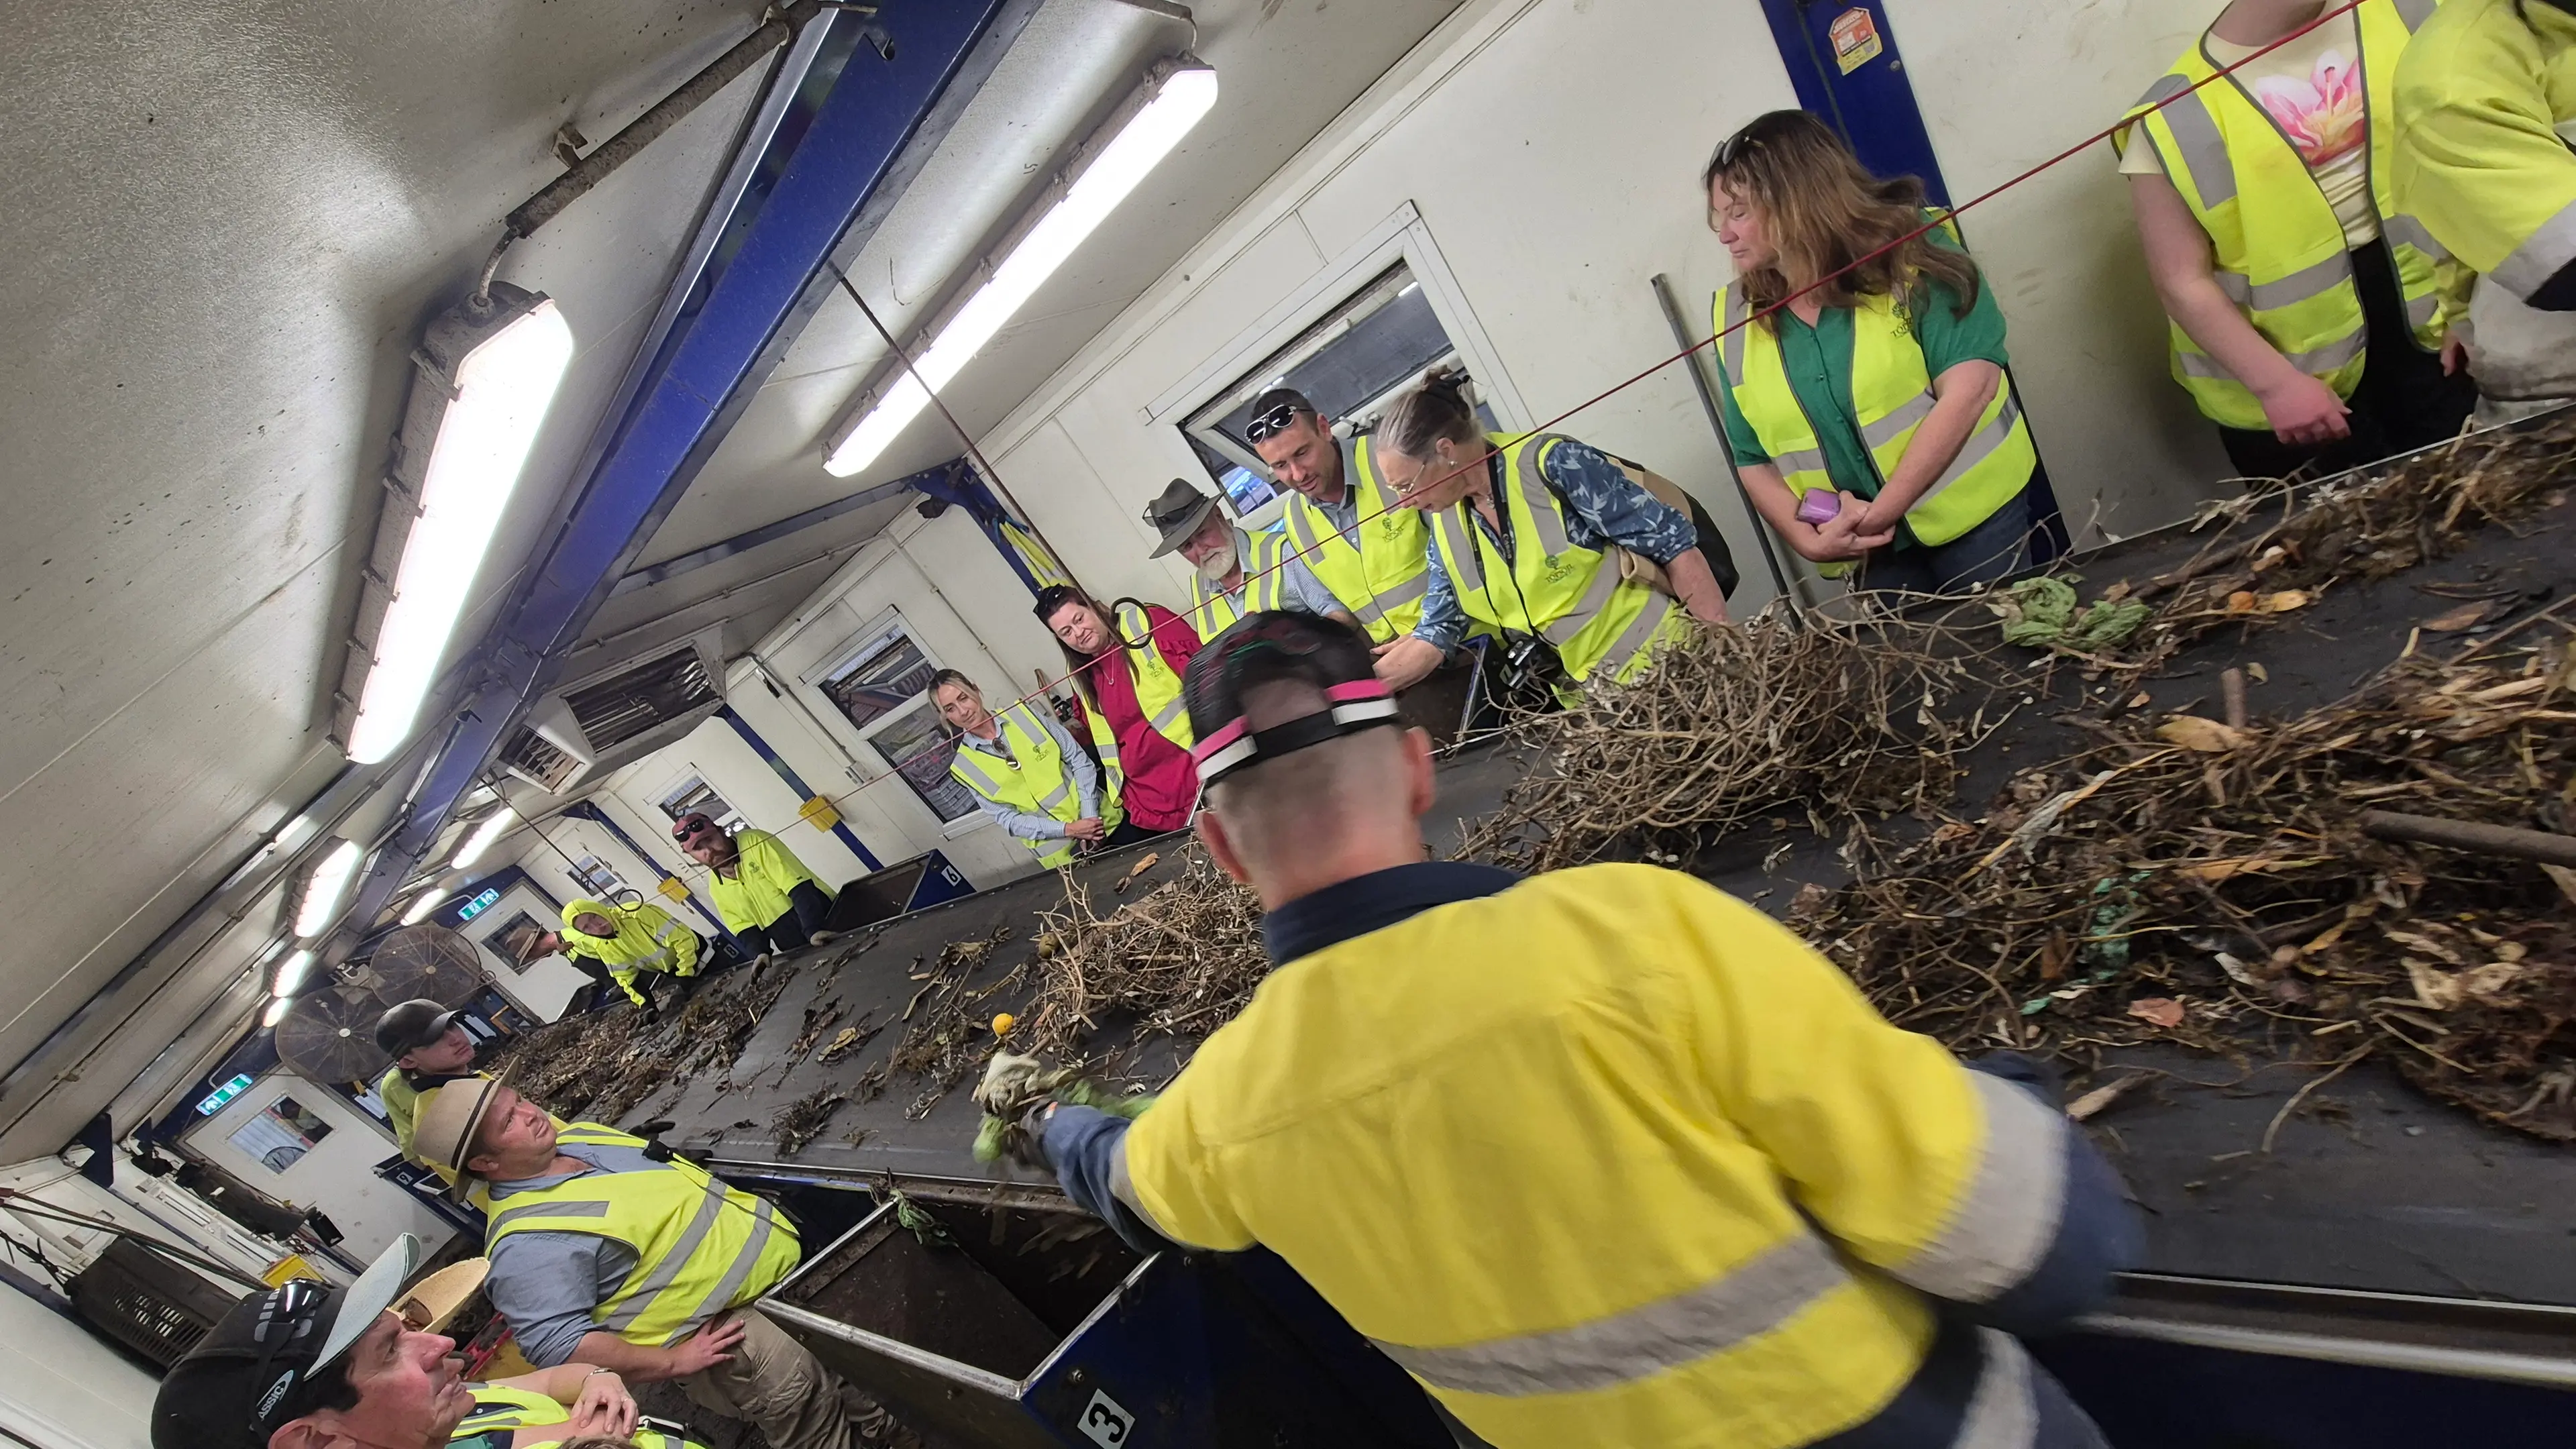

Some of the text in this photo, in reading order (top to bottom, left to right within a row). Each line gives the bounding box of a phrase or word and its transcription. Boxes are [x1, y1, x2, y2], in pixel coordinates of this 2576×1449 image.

[946, 867, 959, 883] 6
[726, 946, 737, 956] 8
[399, 1174, 409, 1182] 9
[254, 1385, 284, 1425] ASSIC
[1088, 1403, 1126, 1443] 3
